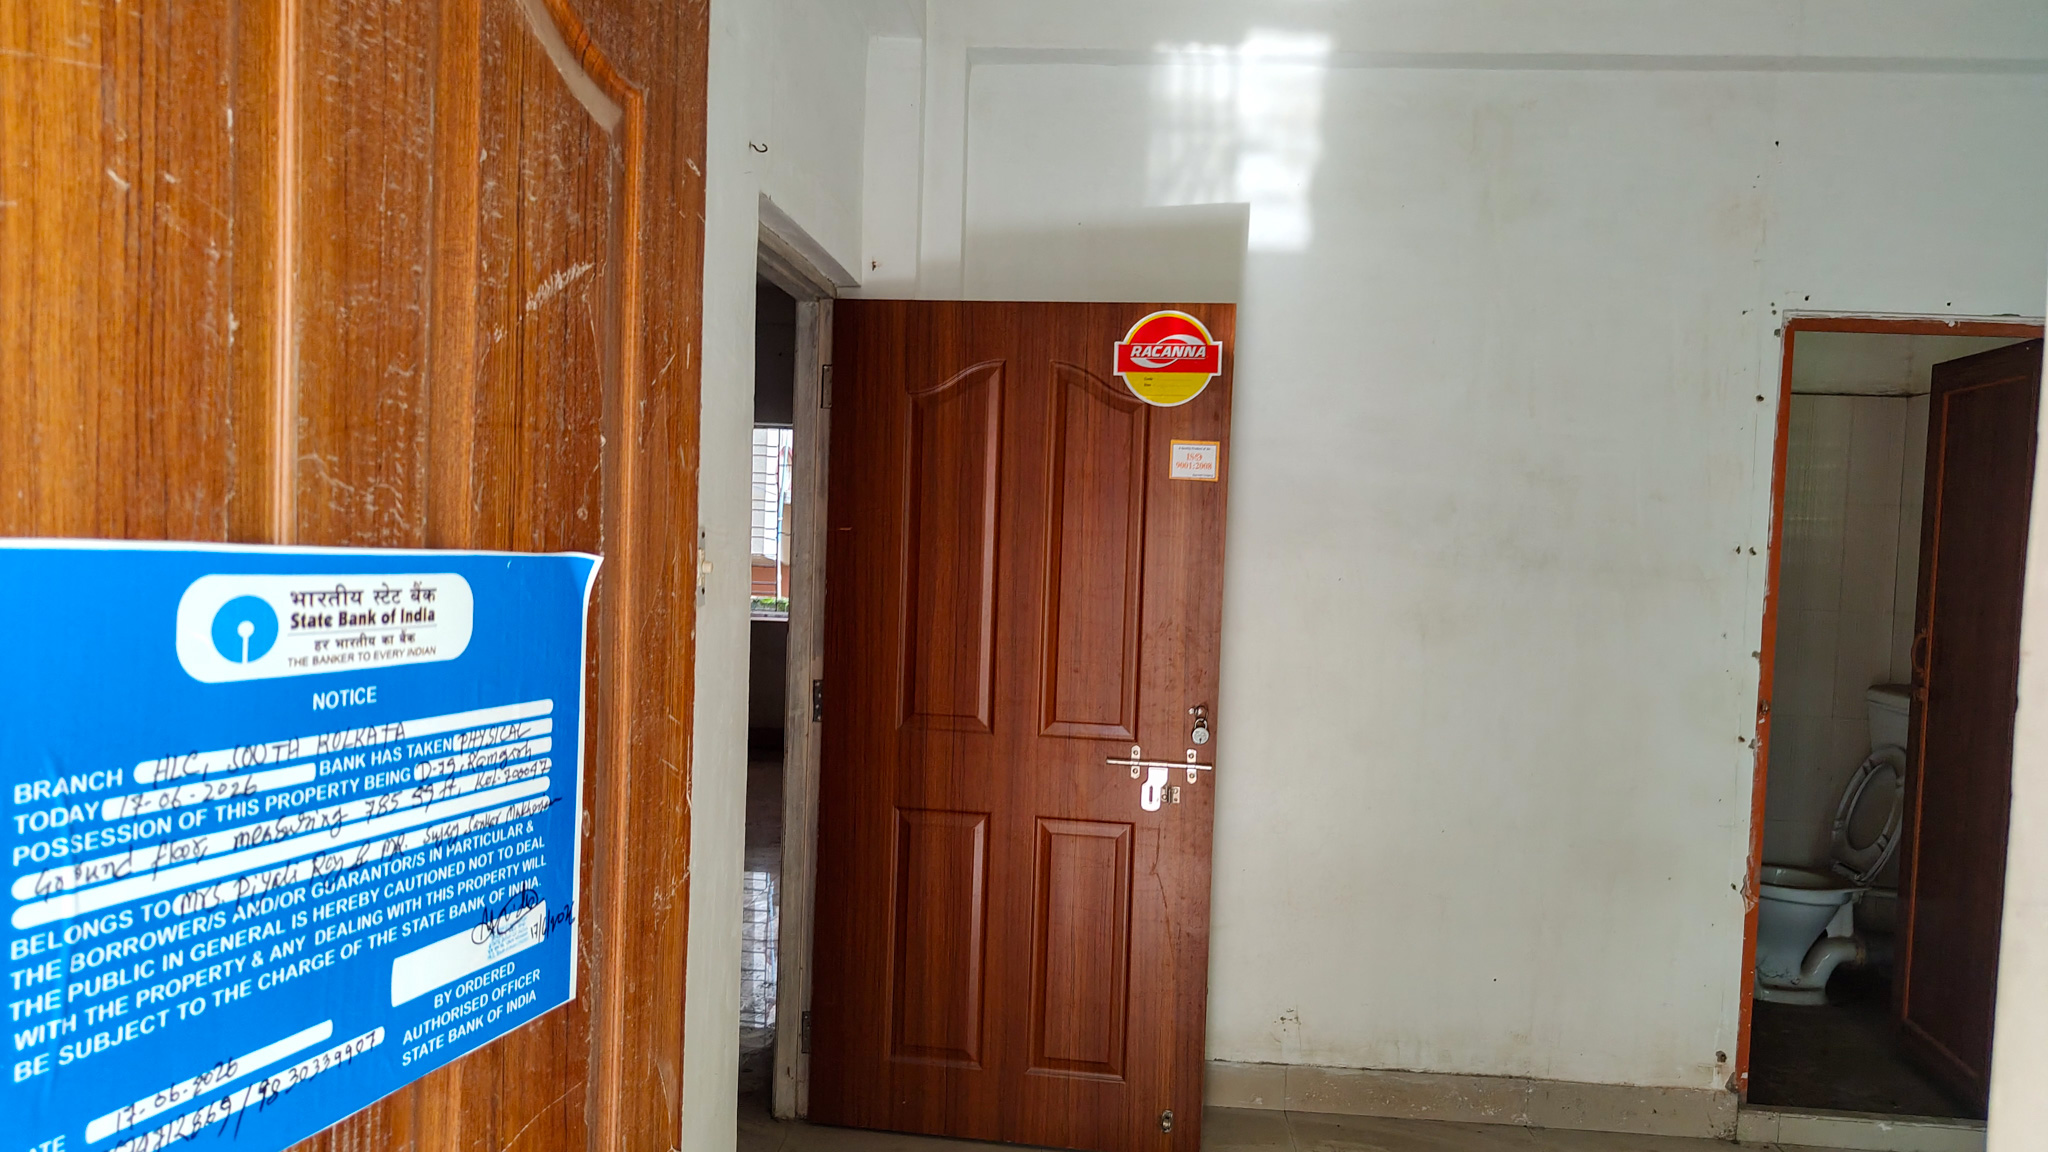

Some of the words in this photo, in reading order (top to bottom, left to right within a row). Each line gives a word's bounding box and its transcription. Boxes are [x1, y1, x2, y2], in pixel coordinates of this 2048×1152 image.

[1130, 345, 1207, 358] RACANNA
[290, 584, 364, 608] भारतीय
[373, 582, 403, 605] स्टेट
[410, 581, 437, 603] बैंक
[290, 611, 333, 630] State
[338, 610, 376, 627] Bank
[381, 608, 396, 624] of
[400, 607, 435, 623] India
[288, 656, 309, 668] THE
[312, 652, 355, 666] BANKER
[358, 651, 371, 662] TO
[373, 648, 405, 661] EVERY
[406, 645, 437, 658] INDIAN
[335, 632, 376, 650] भारतीय
[312, 685, 377, 711] NOTICE
[13, 801, 100, 835] TODAY
[319, 753, 366, 776] BANK
[370, 749, 402, 768] HAS
[406, 739, 453, 759] TAKEN
[457, 723, 531, 755] PHYSICAL
[14, 768, 123, 804] BRANCH
[12, 816, 172, 867] POSSESSION
[178, 808, 208, 830] OF
[214, 798, 259, 823] THIS
[265, 778, 361, 812] PROPERTY
[364, 767, 411, 791] BEING
[8, 988, 62, 1022] THE
[67, 960, 155, 1003] PUBLIC
[162, 950, 184, 972] IN
[189, 920, 286, 962] GENERAL
[291, 910, 308, 930] IS
[312, 887, 382, 923] HEREBY
[383, 863, 466, 899] CAUTIONED
[468, 853, 496, 871] NOT
[498, 846, 513, 860] TO
[516, 836, 545, 856] DEAL
[9, 959, 62, 991] THE
[70, 910, 227, 973] BORROWER/S
[231, 887, 306, 924] AND/OR
[311, 851, 426, 899] GUARANTOR/S
[429, 847, 442, 862] IN
[446, 826, 523, 858] PARTICULAR
[526, 820, 534, 833] &
[10, 909, 134, 961] BELONGS
[140, 899, 171, 923] TO
[14, 1013, 77, 1051] WITH
[84, 995, 129, 1026] THE
[136, 955, 247, 1009] PROPERTY
[251, 950, 264, 968] &
[269, 933, 306, 962] ANY
[314, 908, 384, 946] DEALING
[386, 898, 423, 920] WITH
[426, 887, 454, 907] THIS
[457, 862, 522, 894] PROPERTY
[522, 855, 547, 875] WILL
[13, 1052, 50, 1084] BE
[58, 1008, 170, 1066] SUBJECT
[176, 997, 207, 1020] TO
[212, 980, 252, 1008] THE
[257, 949, 336, 991] CHARGE
[340, 939, 363, 960] OF
[368, 929, 398, 951] THE
[401, 909, 446, 938] STATE
[449, 896, 486, 920] BANK
[488, 887, 506, 904] OF
[402, 992, 489, 1046] AUTHORISED
[491, 968, 541, 1001] OFFICER
[433, 990, 452, 1009] BY
[455, 961, 516, 999] ORDERED
[402, 1032, 445, 1067] STATE
[448, 1014, 484, 1043] BANK
[487, 1006, 504, 1023] OF
[506, 989, 537, 1014] INDIA
